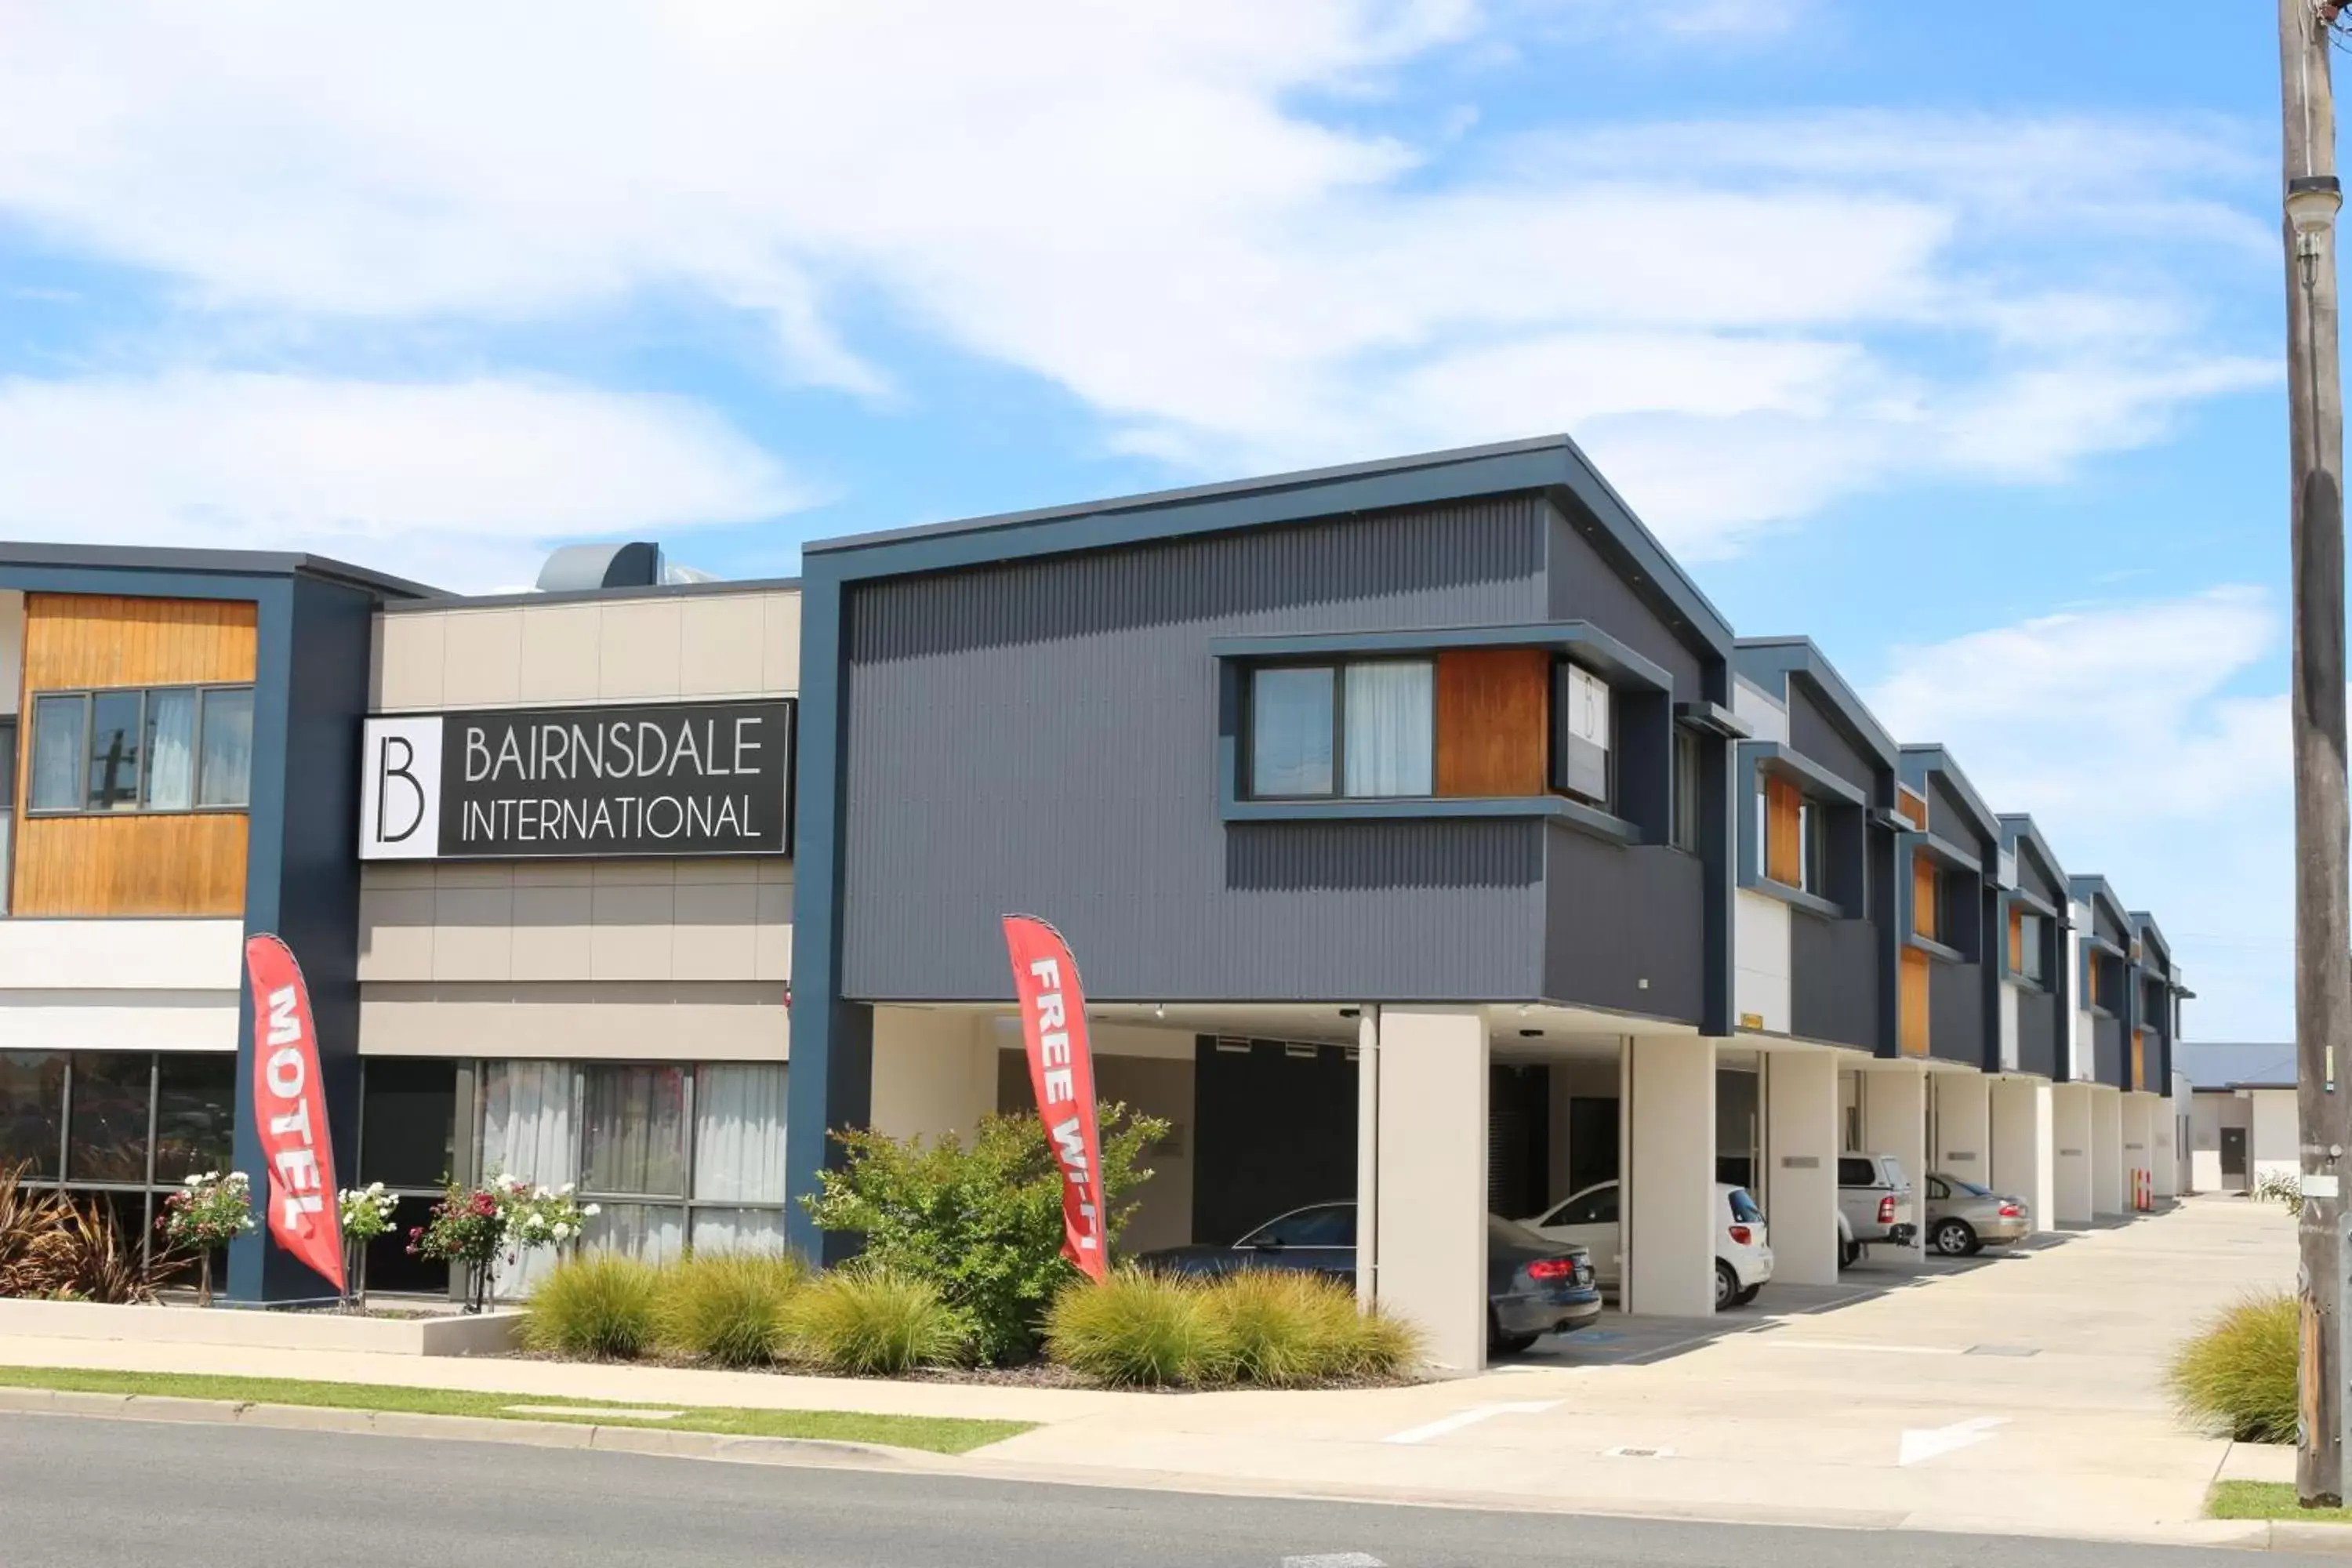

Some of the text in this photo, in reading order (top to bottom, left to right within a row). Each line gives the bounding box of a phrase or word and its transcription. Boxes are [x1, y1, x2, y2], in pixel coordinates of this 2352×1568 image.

[376, 735, 425, 843] B
[465, 717, 763, 782] BAIRNSDALE
[462, 794, 761, 842] INTERNATIONAL
[1030, 957, 1074, 1106] FREE
[266, 985, 324, 1230] MOTEL
